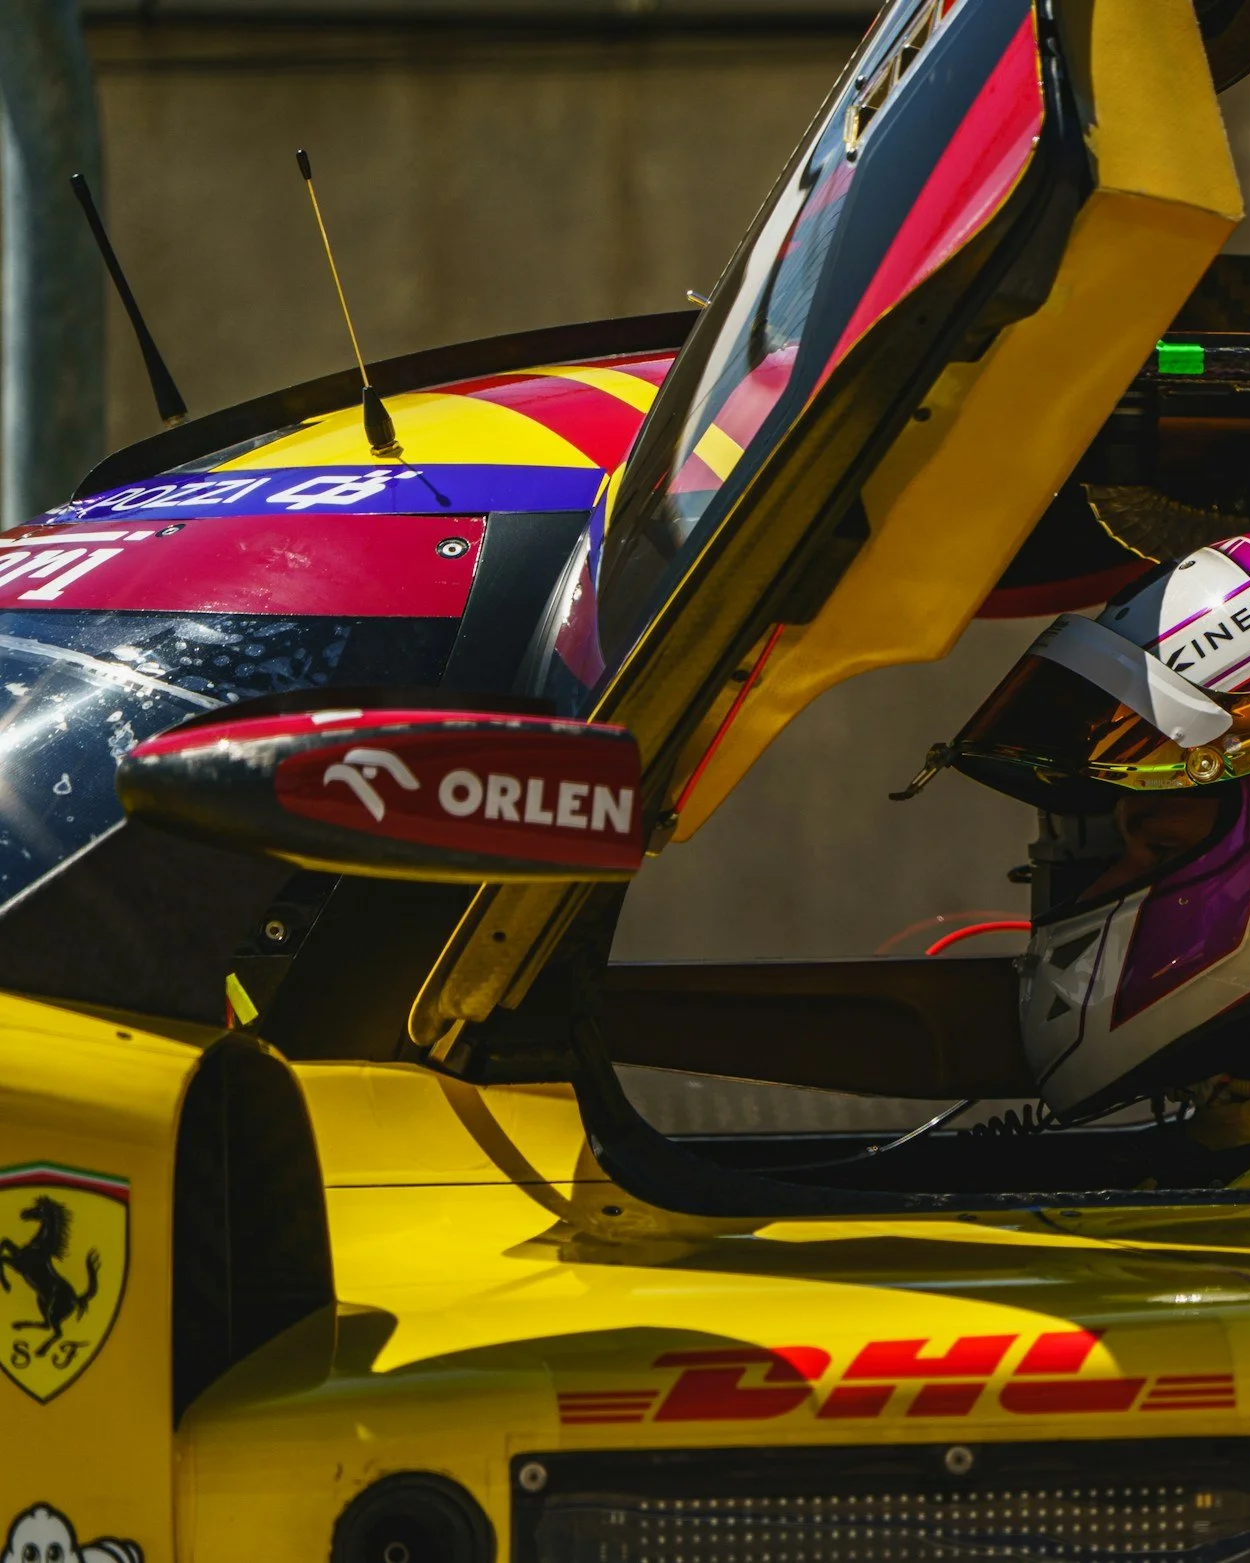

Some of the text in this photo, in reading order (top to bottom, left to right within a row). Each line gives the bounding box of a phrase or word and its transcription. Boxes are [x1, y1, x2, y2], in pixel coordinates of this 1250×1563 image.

[439, 769, 634, 834] ORLEN
[10, 1339, 32, 1370] S
[652, 1329, 1148, 1423] DHL
